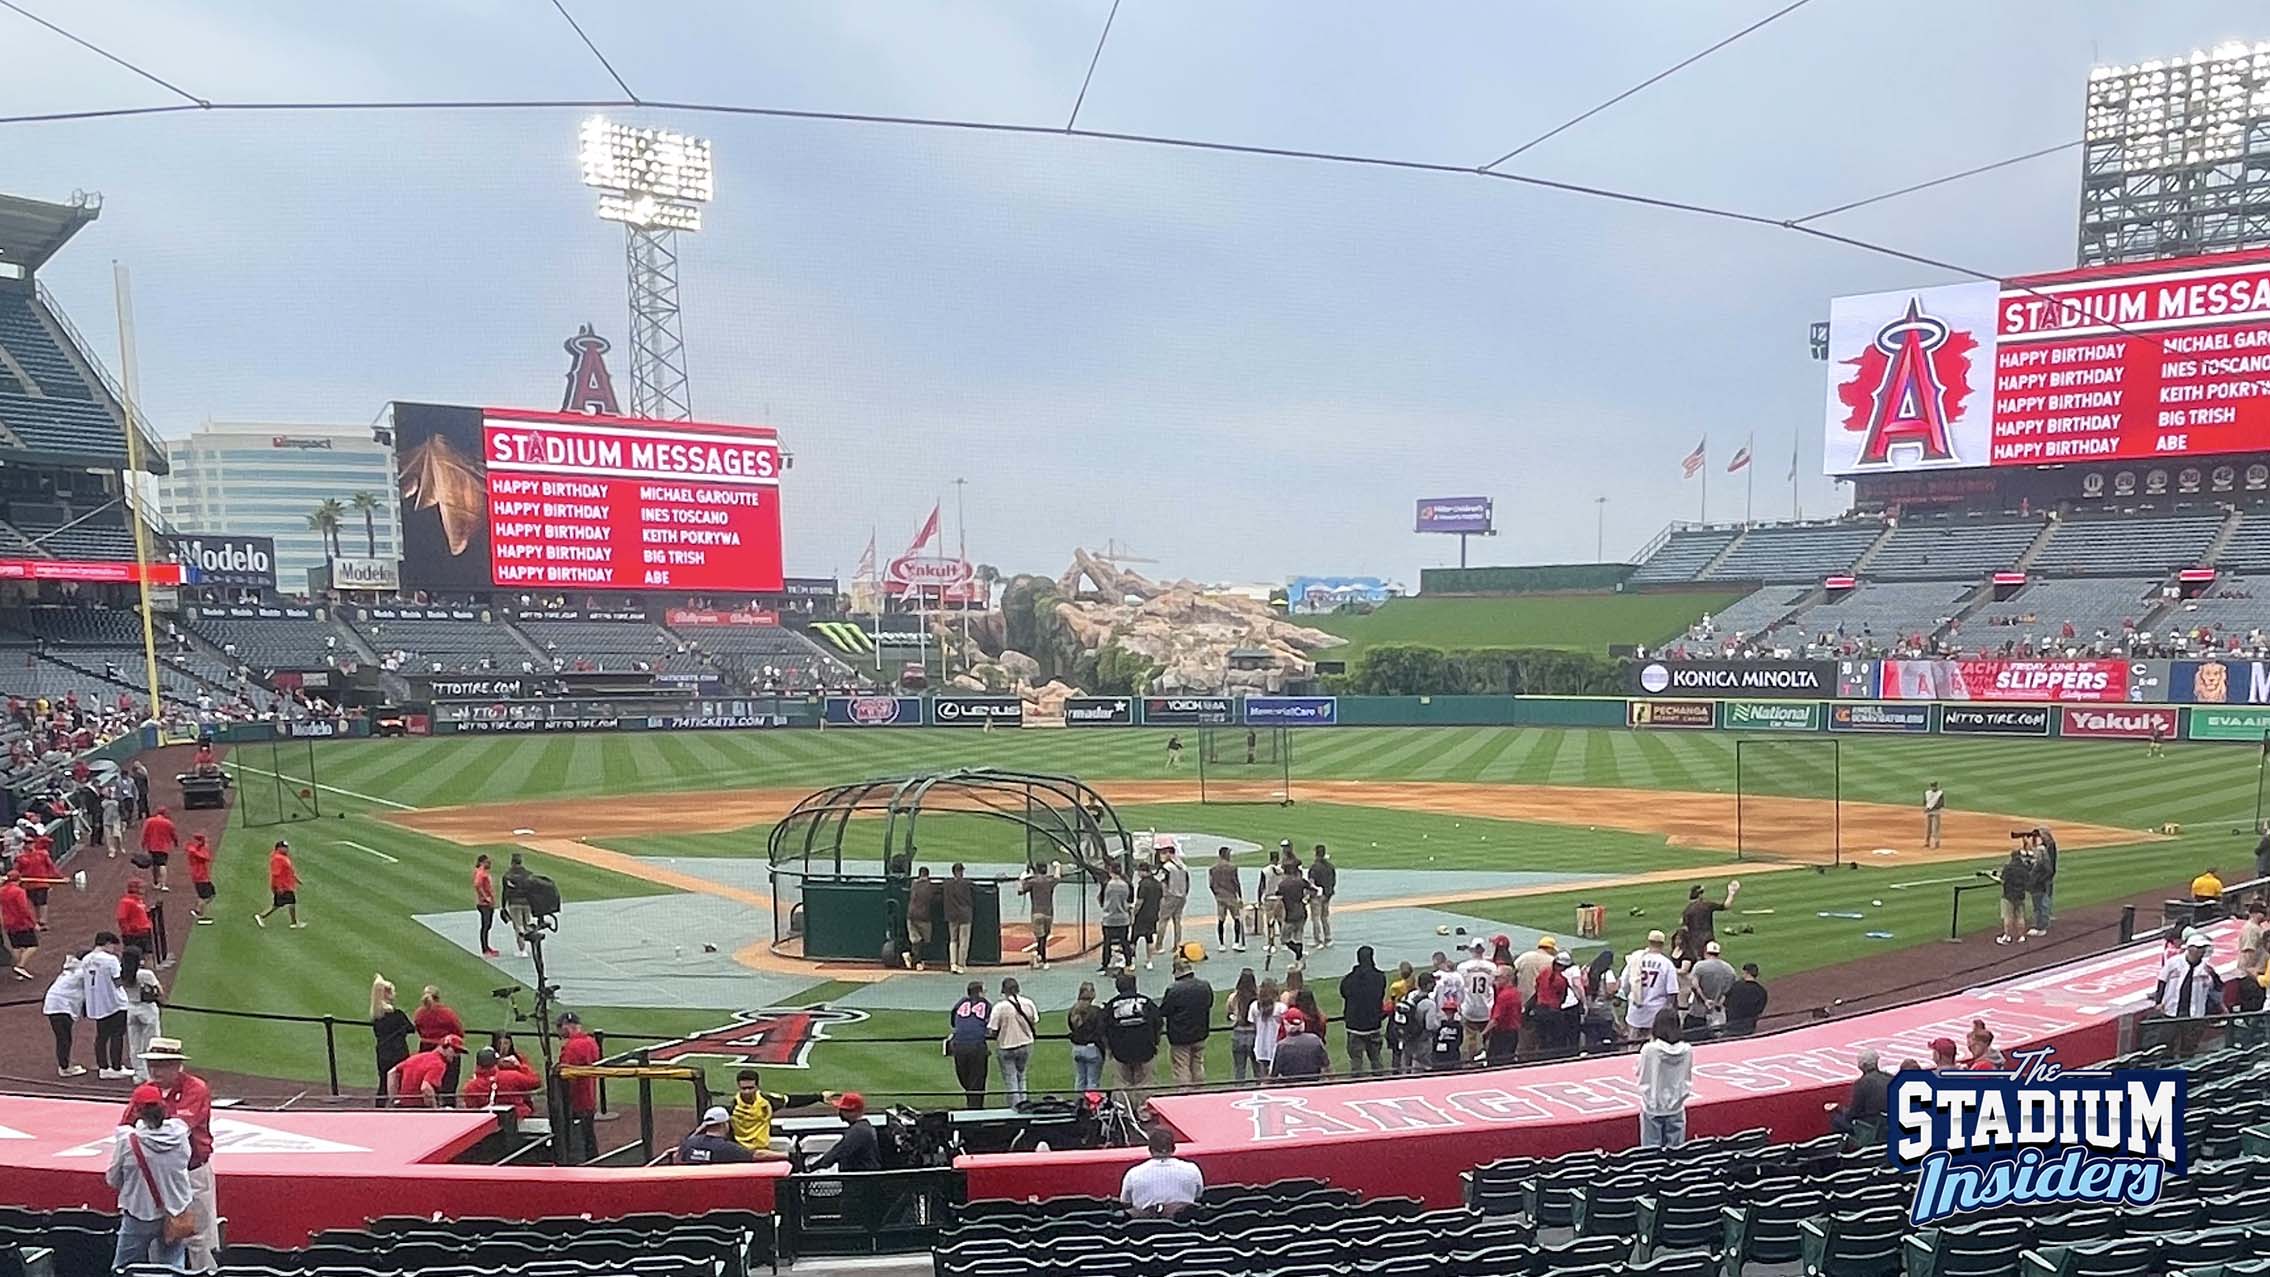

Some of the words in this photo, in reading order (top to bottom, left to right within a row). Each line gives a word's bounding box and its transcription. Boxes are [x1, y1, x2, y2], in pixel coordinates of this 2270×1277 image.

[2005, 291, 2147, 333] STADIUM
[2163, 333, 2232, 354] MICHAEL
[2234, 330, 2270, 348] GAR
[2000, 350, 2049, 369] HAPPY
[2051, 343, 2126, 365] BIRTHDAY
[1998, 374, 2047, 391] HAPPY
[2049, 367, 2124, 387] BIRTHDAY
[2161, 361, 2197, 378] INES
[1997, 396, 2046, 414] HAPPY
[2048, 390, 2123, 410] BIRTHDAY
[2160, 385, 2203, 403] KEITH
[1996, 420, 2044, 437] HAPPY
[2046, 413, 2122, 433] BIRTHDAY
[2158, 410, 2186, 427] BIG
[2189, 407, 2236, 425] TRISH
[1994, 443, 2043, 460] HAPPY
[2045, 438, 2120, 457] BIRTHDAY
[2156, 435, 2188, 451] ABE
[493, 431, 623, 468] STADIUM
[631, 442, 773, 477] MESSAGES
[492, 479, 539, 497] HAPPY
[542, 481, 608, 499] BIRTHDAY
[641, 486, 694, 502] MICHAEL
[696, 489, 759, 506] GAROUTTE
[493, 501, 541, 519] HAPPY
[543, 503, 609, 520] BIRTHDAY
[641, 508, 670, 522] INES
[671, 510, 728, 525] TOSCANO
[496, 522, 542, 540] HAPPY
[545, 524, 611, 541] BIRTHDAY
[642, 529, 678, 544] KEITH
[680, 530, 740, 545] POKRYWA
[180, 541, 269, 573] Modelo
[497, 544, 543, 561] HAPPY
[545, 545, 612, 562] BIRTHDAY
[643, 549, 667, 563] BIG
[669, 550, 705, 565] TRISH
[340, 562, 391, 581] Modelo
[498, 565, 544, 581] HAPPY
[546, 566, 613, 583] BIRTHDAY
[644, 570, 670, 584] ABE
[1673, 671, 1739, 688] KONICA
[1741, 671, 1819, 688] MINOLTA
[1996, 672, 2109, 689] SLIPPERS
[1750, 704, 1810, 720] National
[1946, 712, 1985, 724] NITTO
[1987, 713, 2046, 726] TIRE.COM
[2071, 712, 2169, 732] Yakult
[1471, 977, 1487, 995] 13
